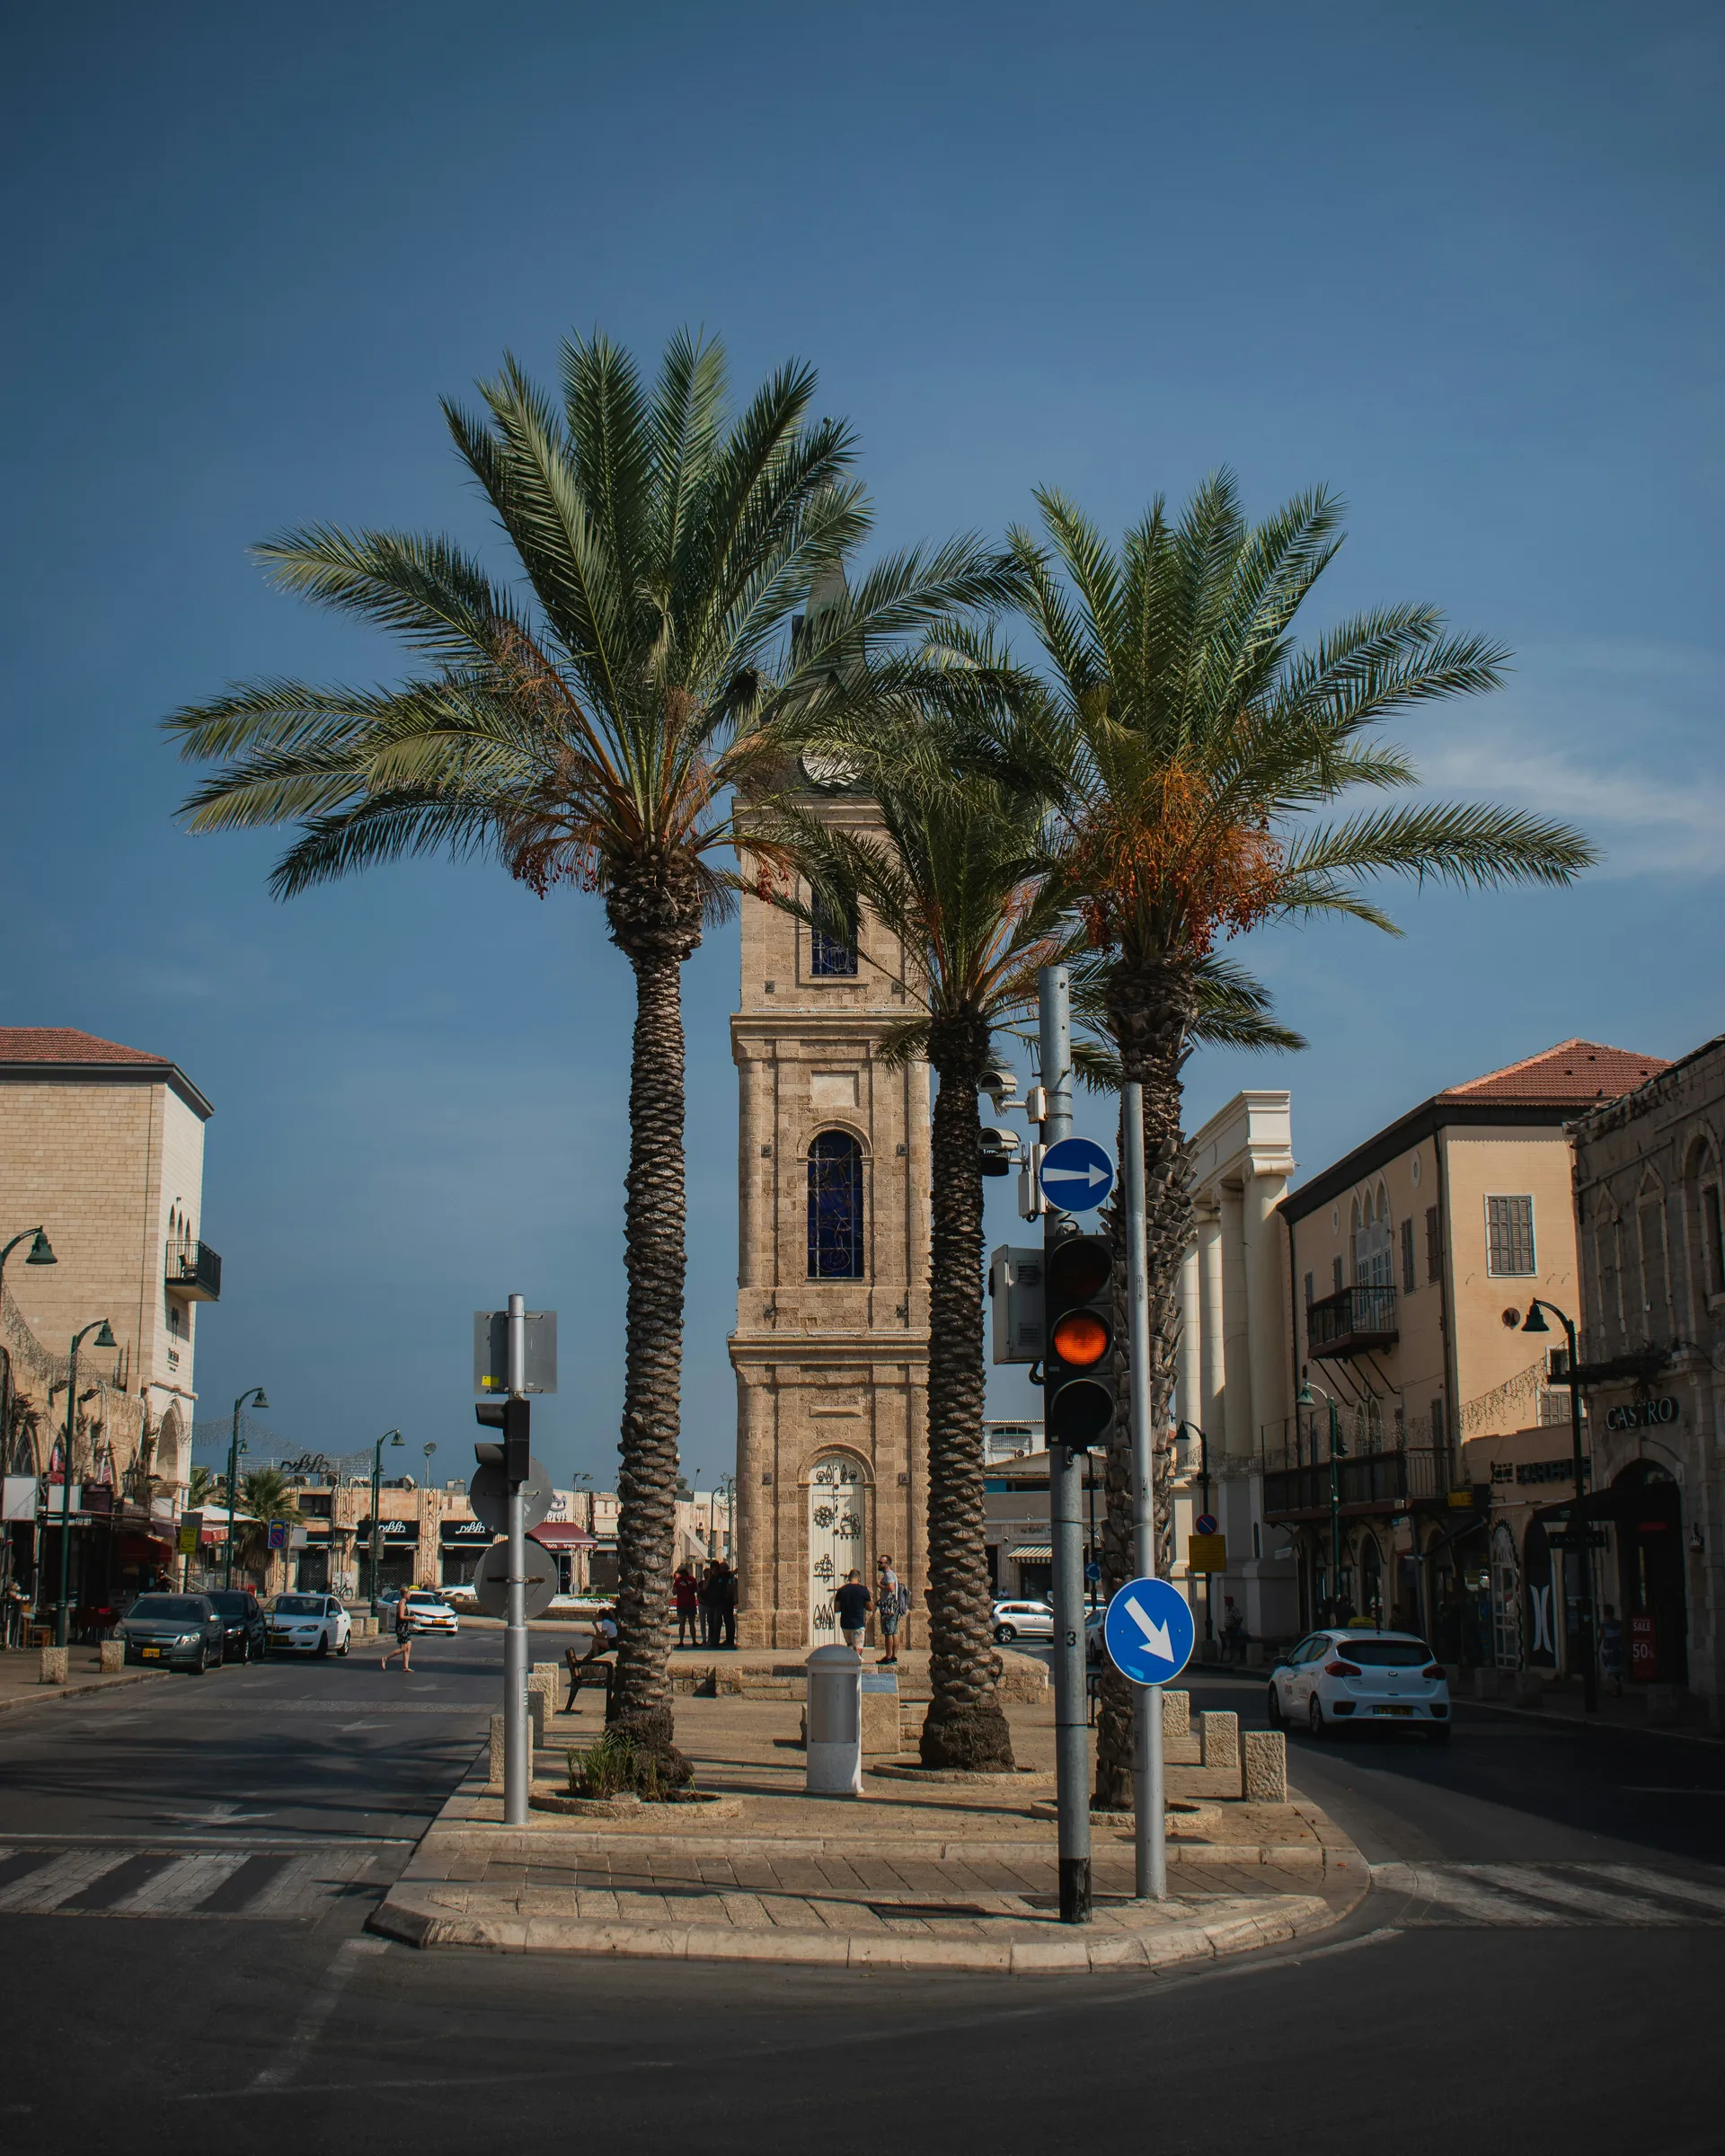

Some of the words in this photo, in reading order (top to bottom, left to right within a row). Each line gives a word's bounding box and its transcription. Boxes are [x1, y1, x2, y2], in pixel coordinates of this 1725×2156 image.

[1606, 1397, 1676, 1430] CASRO
[1632, 1621, 1650, 1631] SALE
[1066, 1631, 1076, 1647] 3
